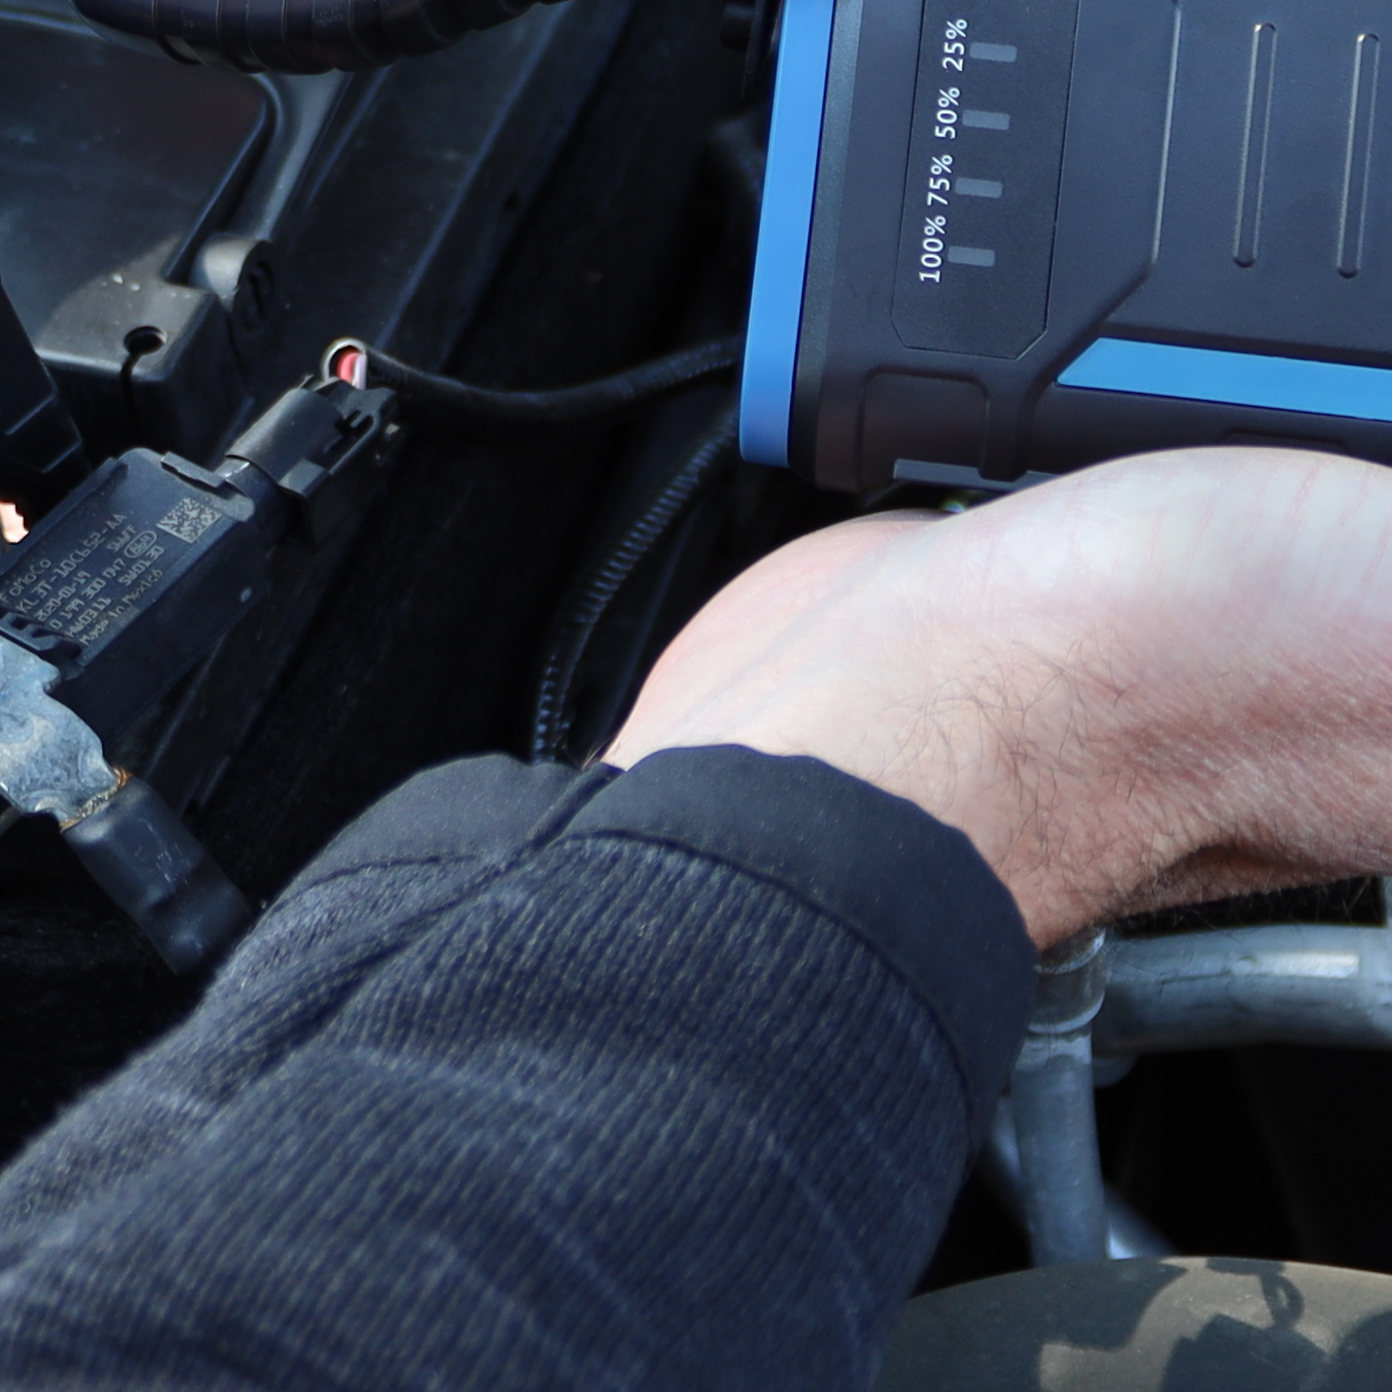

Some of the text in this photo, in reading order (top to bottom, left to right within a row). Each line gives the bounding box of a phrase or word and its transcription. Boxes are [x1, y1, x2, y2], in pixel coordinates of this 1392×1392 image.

[942, 18, 968, 72] 25%
[935, 86, 961, 139] 50%
[927, 154, 953, 206] 75%
[919, 214, 948, 283] 100%
[0, 558, 52, 604] FoMoCo
